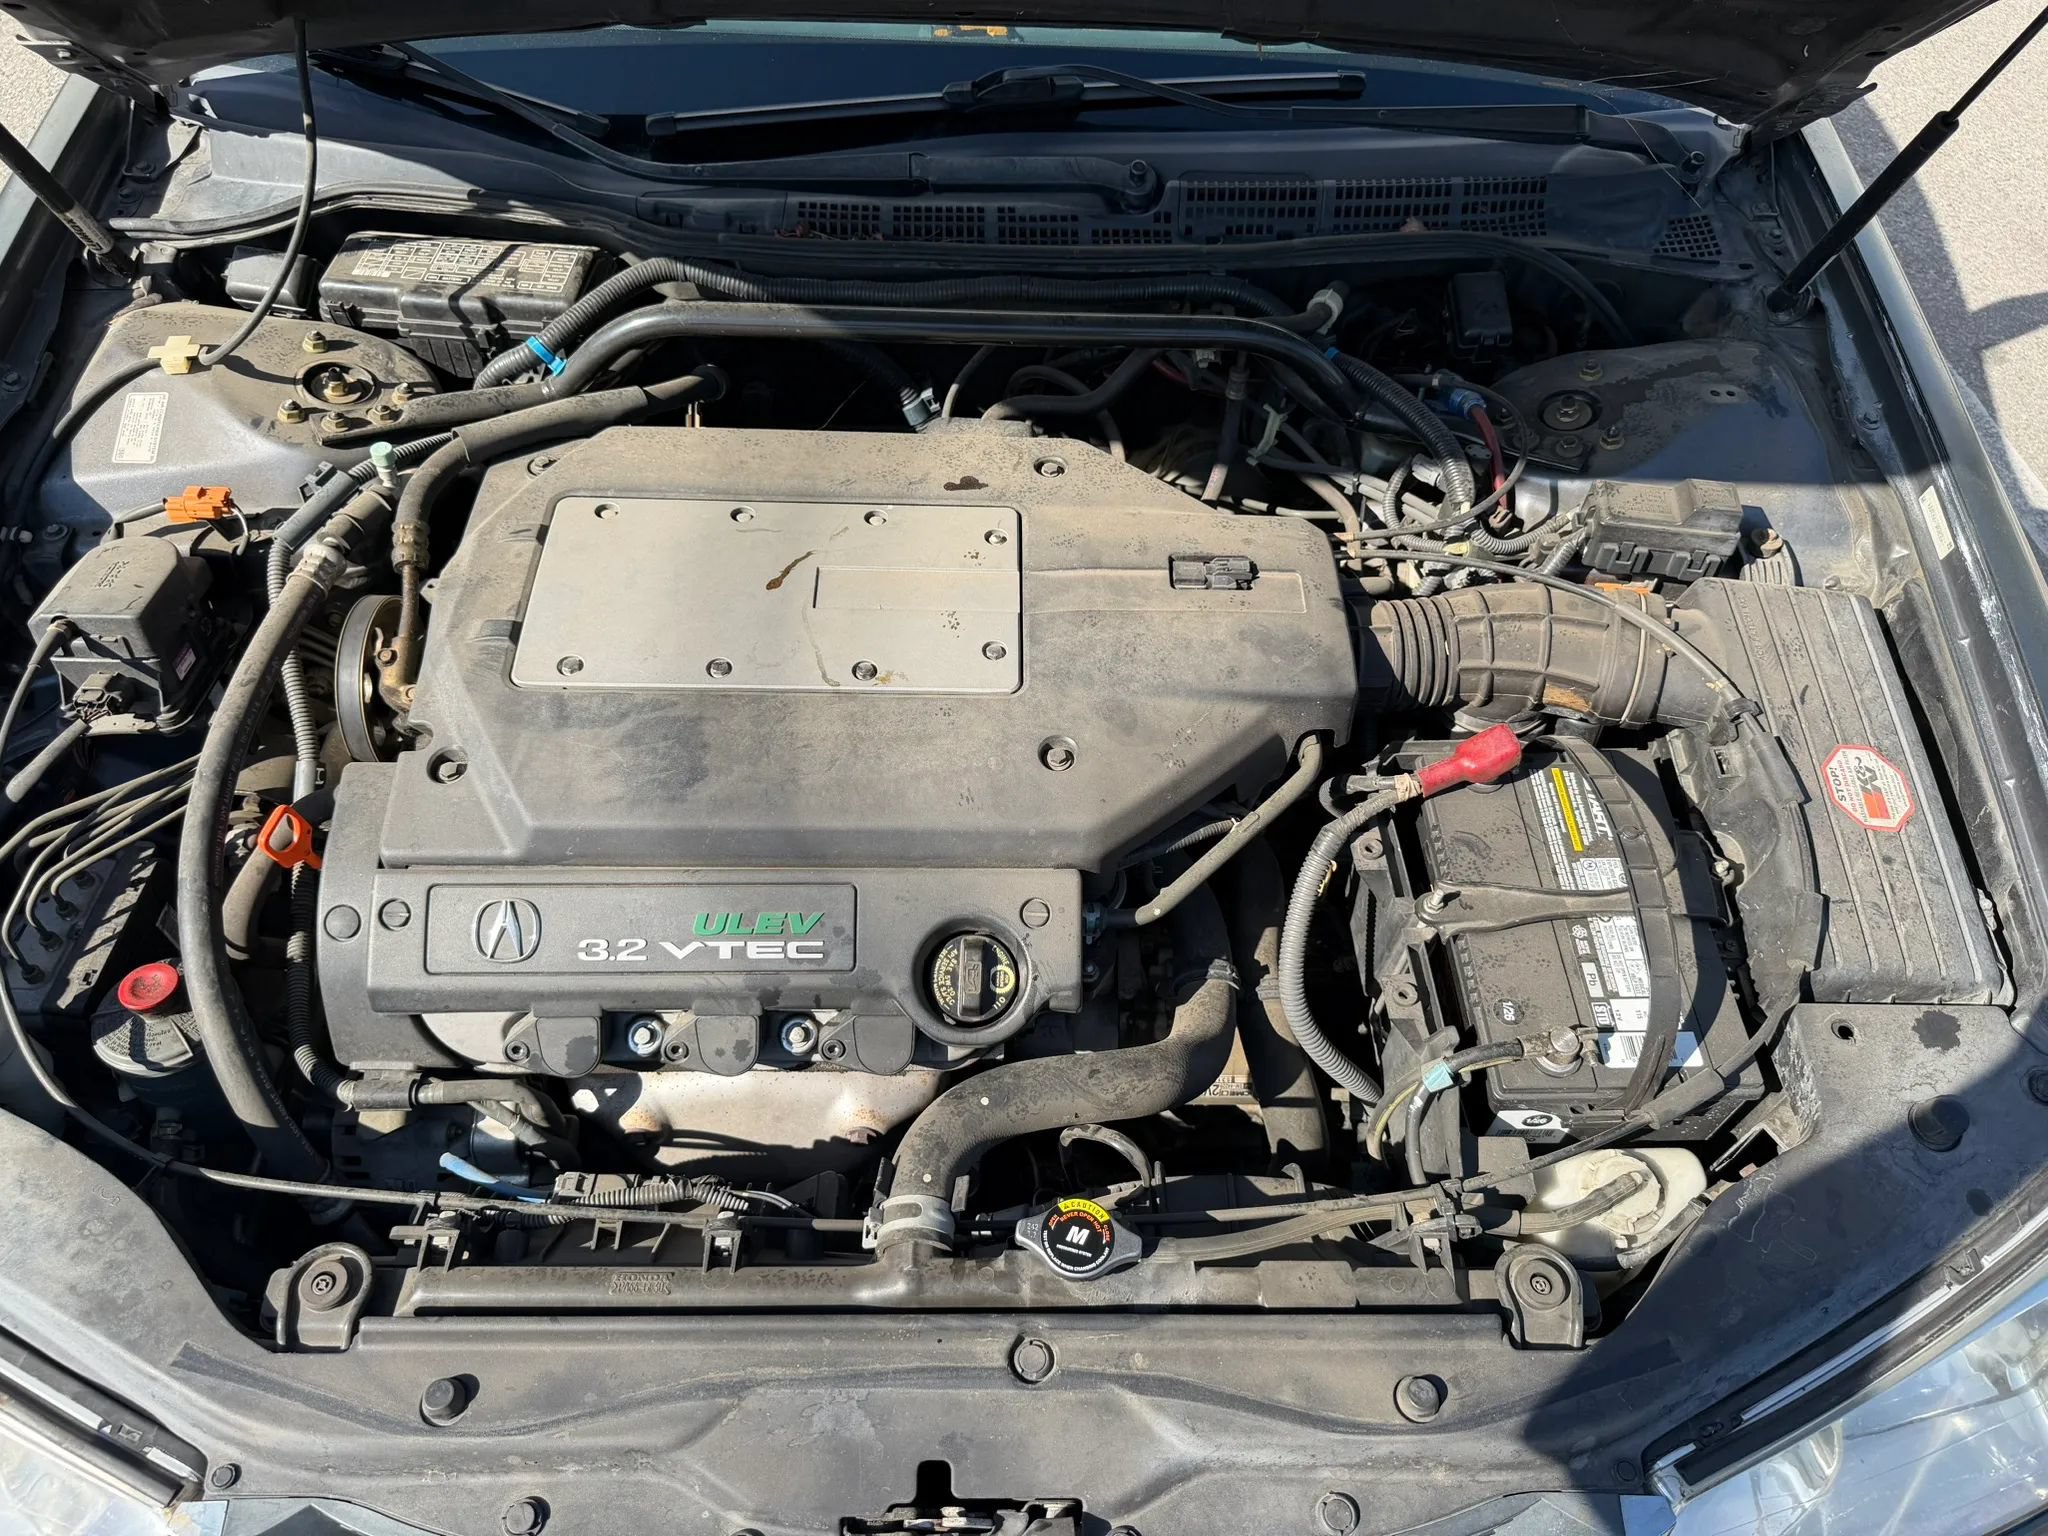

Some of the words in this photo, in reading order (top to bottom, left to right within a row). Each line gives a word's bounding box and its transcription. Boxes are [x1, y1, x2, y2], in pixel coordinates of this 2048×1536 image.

[1829, 767, 1847, 802] STOP!
[1846, 787, 1855, 802] NOT
[692, 911, 825, 937] ULEV
[577, 938, 649, 962] 3.2
[658, 939, 825, 960] VTEC
[992, 945, 1010, 966] ENGINE
[938, 957, 950, 986] SERVICE
[947, 959, 957, 972] SAE
[1586, 973, 1598, 986] Pb
[993, 996, 1006, 1010] OIL
[1502, 1001, 1516, 1022] 1/26
[1594, 1005, 1610, 1026] STD
[1071, 1201, 1106, 1219] CAUTION
[1060, 1211, 1079, 1222] NEVER
[1079, 1211, 1095, 1222] OPEN
[1093, 1220, 1103, 1233] HOT
[1065, 1225, 1090, 1246] M
[611, 1272, 672, 1282] HONDA
